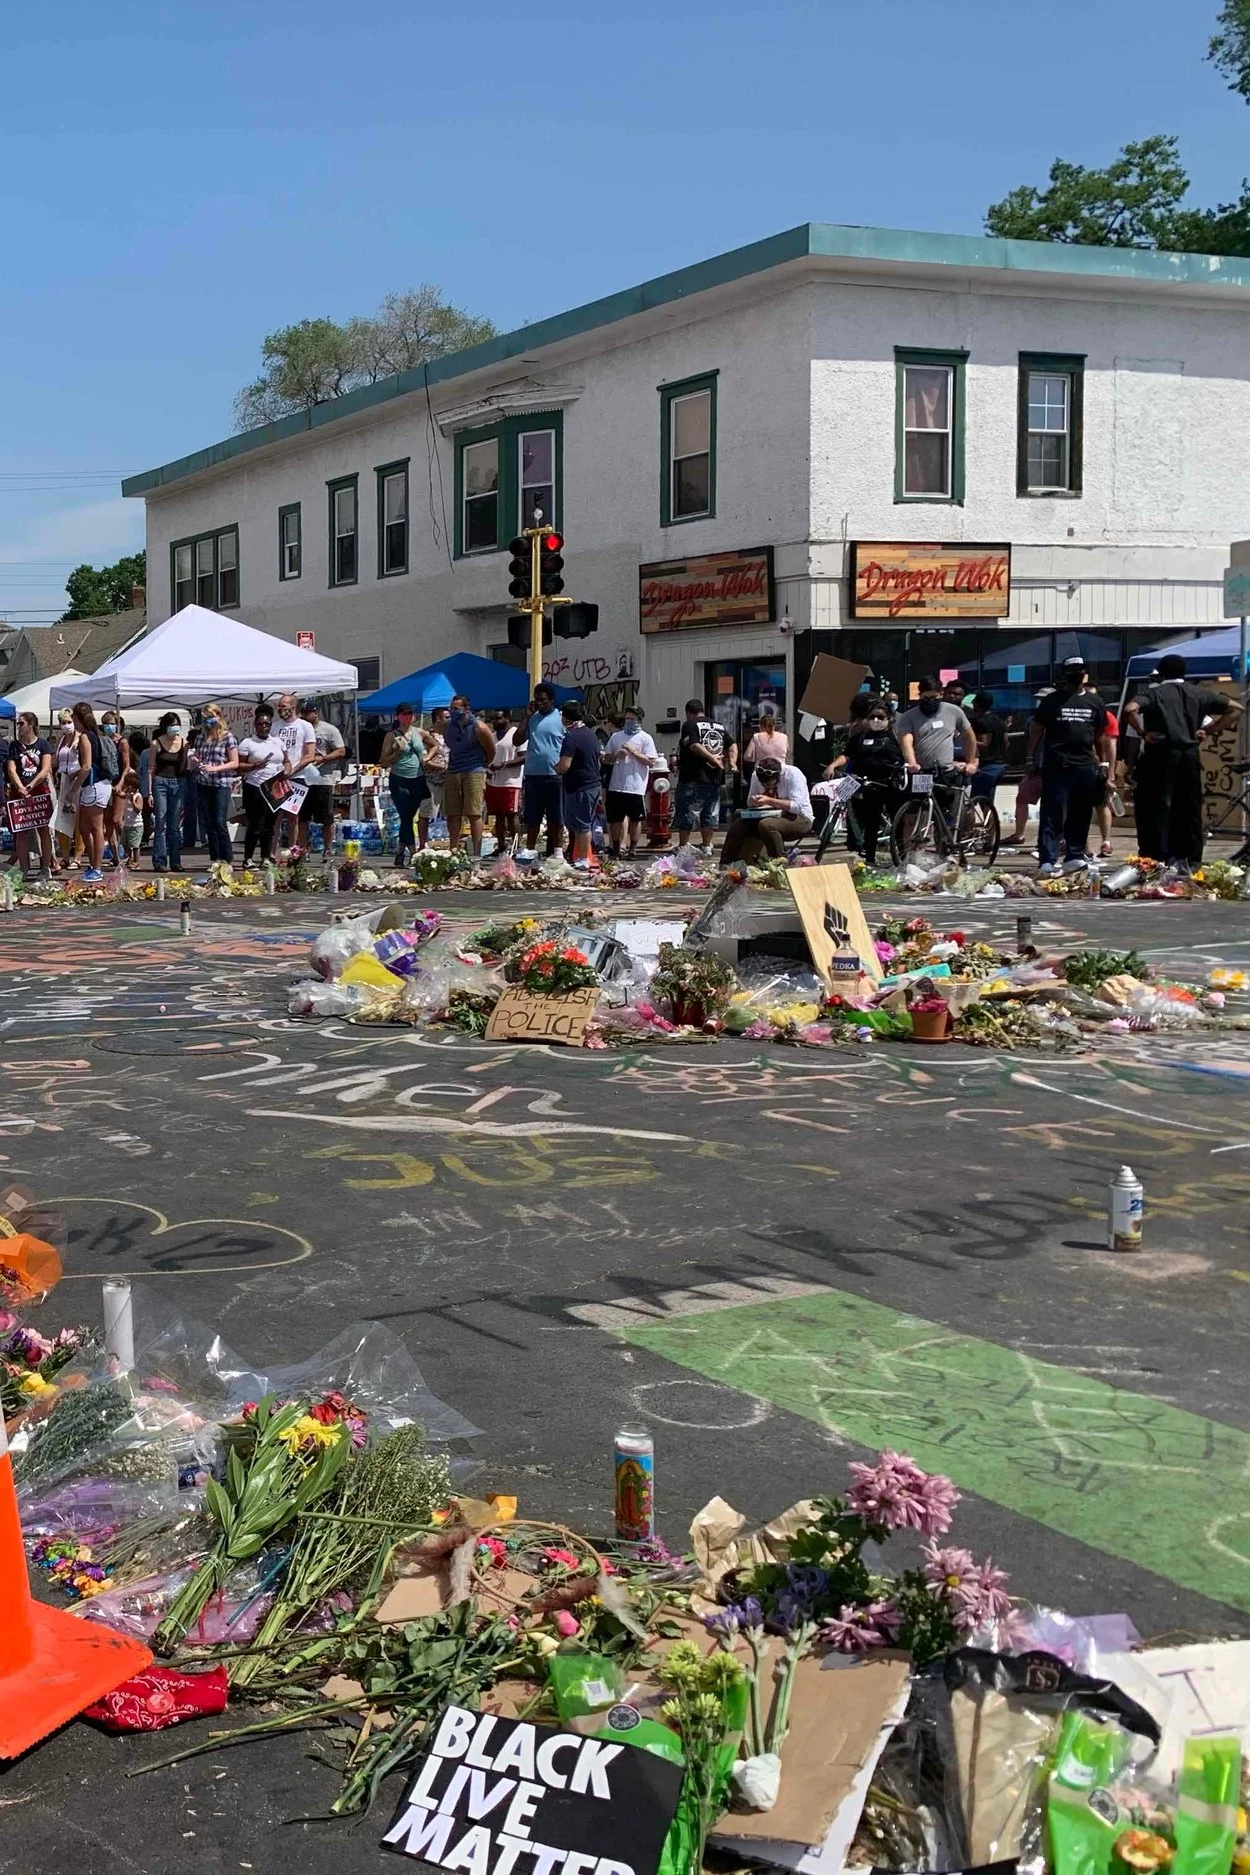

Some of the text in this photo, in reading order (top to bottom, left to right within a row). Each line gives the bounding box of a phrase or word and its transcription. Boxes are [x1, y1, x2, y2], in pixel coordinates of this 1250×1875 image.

[641, 561, 766, 628] Dragon Wok
[857, 556, 1007, 616] Dragon Wok
[492, 1009, 586, 1040] POLICE
[524, 1002, 551, 1010] THE
[431, 1705, 625, 1800] BLACK
[407, 1754, 547, 1840] LIVE
